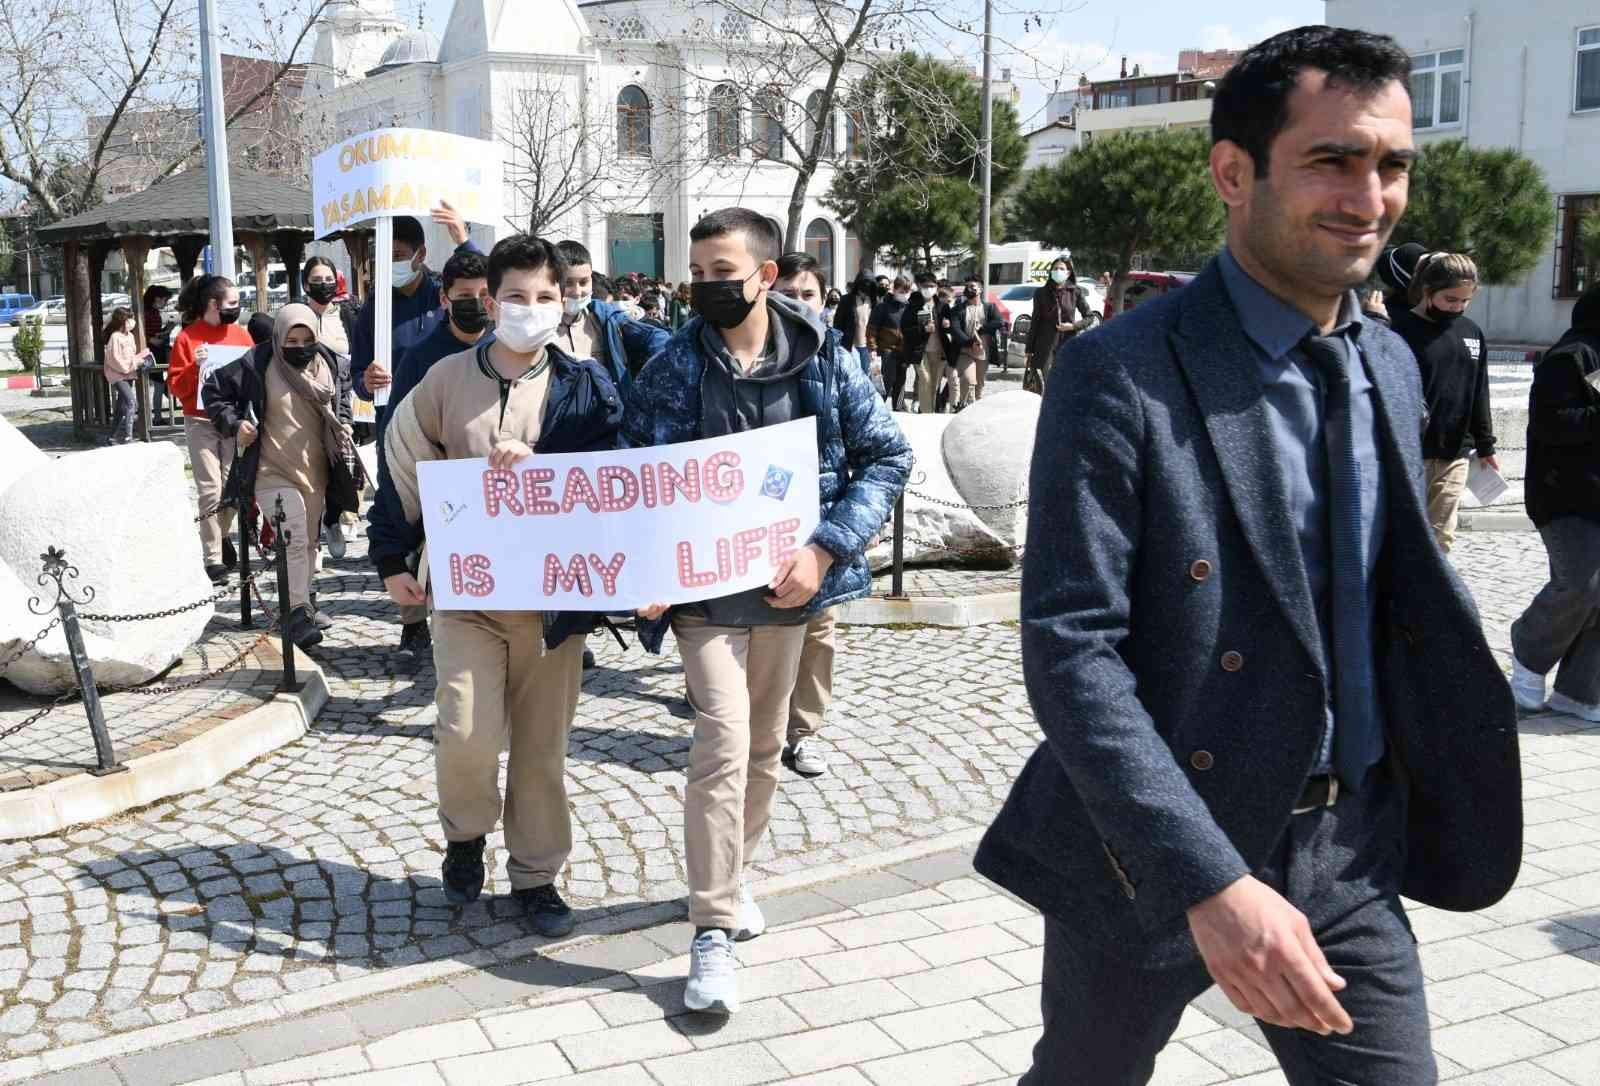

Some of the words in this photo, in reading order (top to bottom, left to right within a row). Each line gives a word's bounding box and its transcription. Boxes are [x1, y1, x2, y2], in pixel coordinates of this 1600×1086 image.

[483, 451, 745, 517] READING
[449, 552, 495, 597] IS
[542, 552, 626, 597] MY
[676, 517, 801, 588] LIFE
